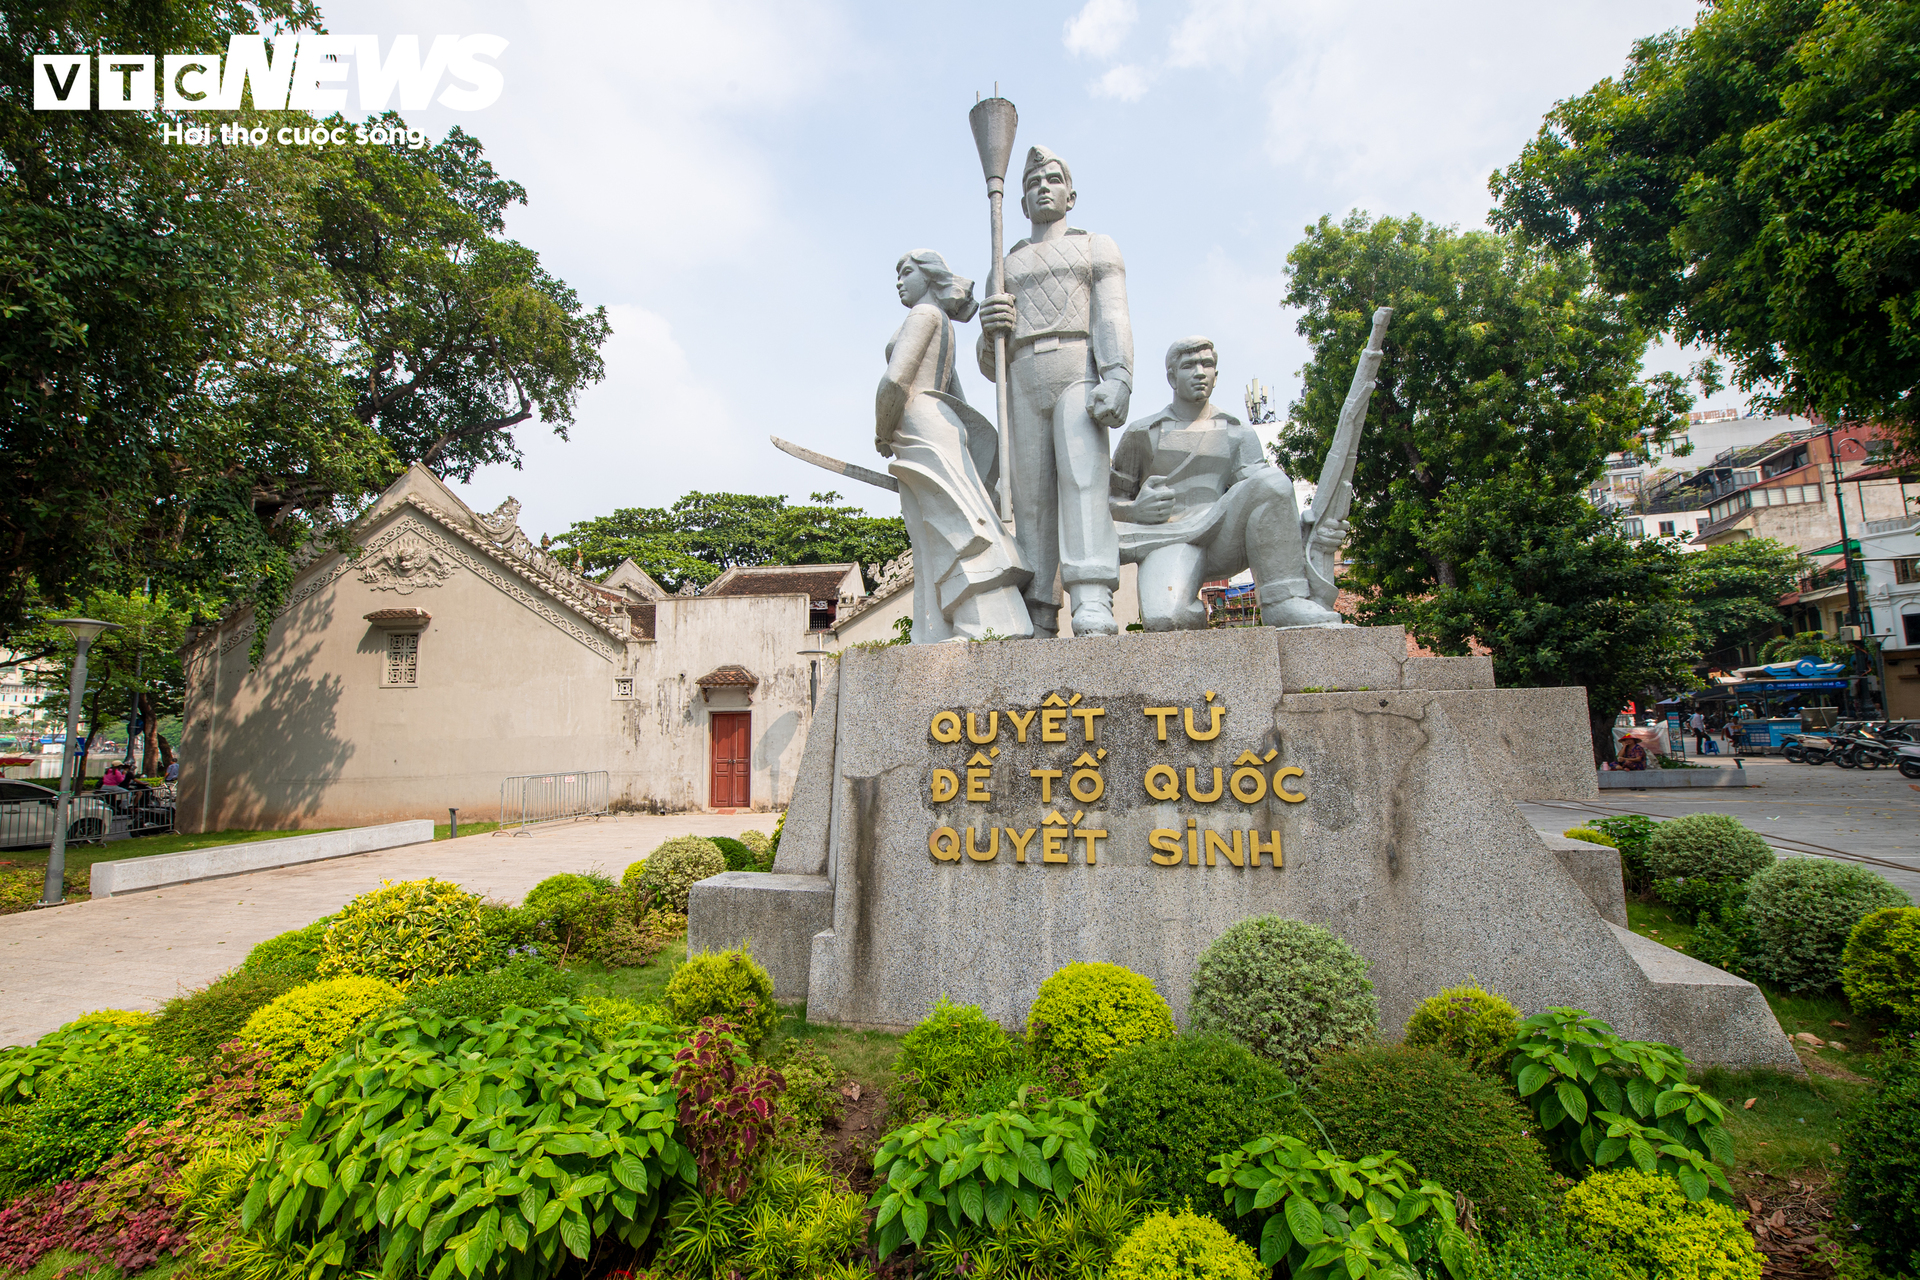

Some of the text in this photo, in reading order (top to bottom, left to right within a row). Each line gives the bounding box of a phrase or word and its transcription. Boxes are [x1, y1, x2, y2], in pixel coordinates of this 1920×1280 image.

[930, 690, 1226, 743] QUYẾT TỬ
[930, 746, 1307, 804] ĐỂ TỔ QUỐC
[929, 810, 1108, 864] QUYẾT
